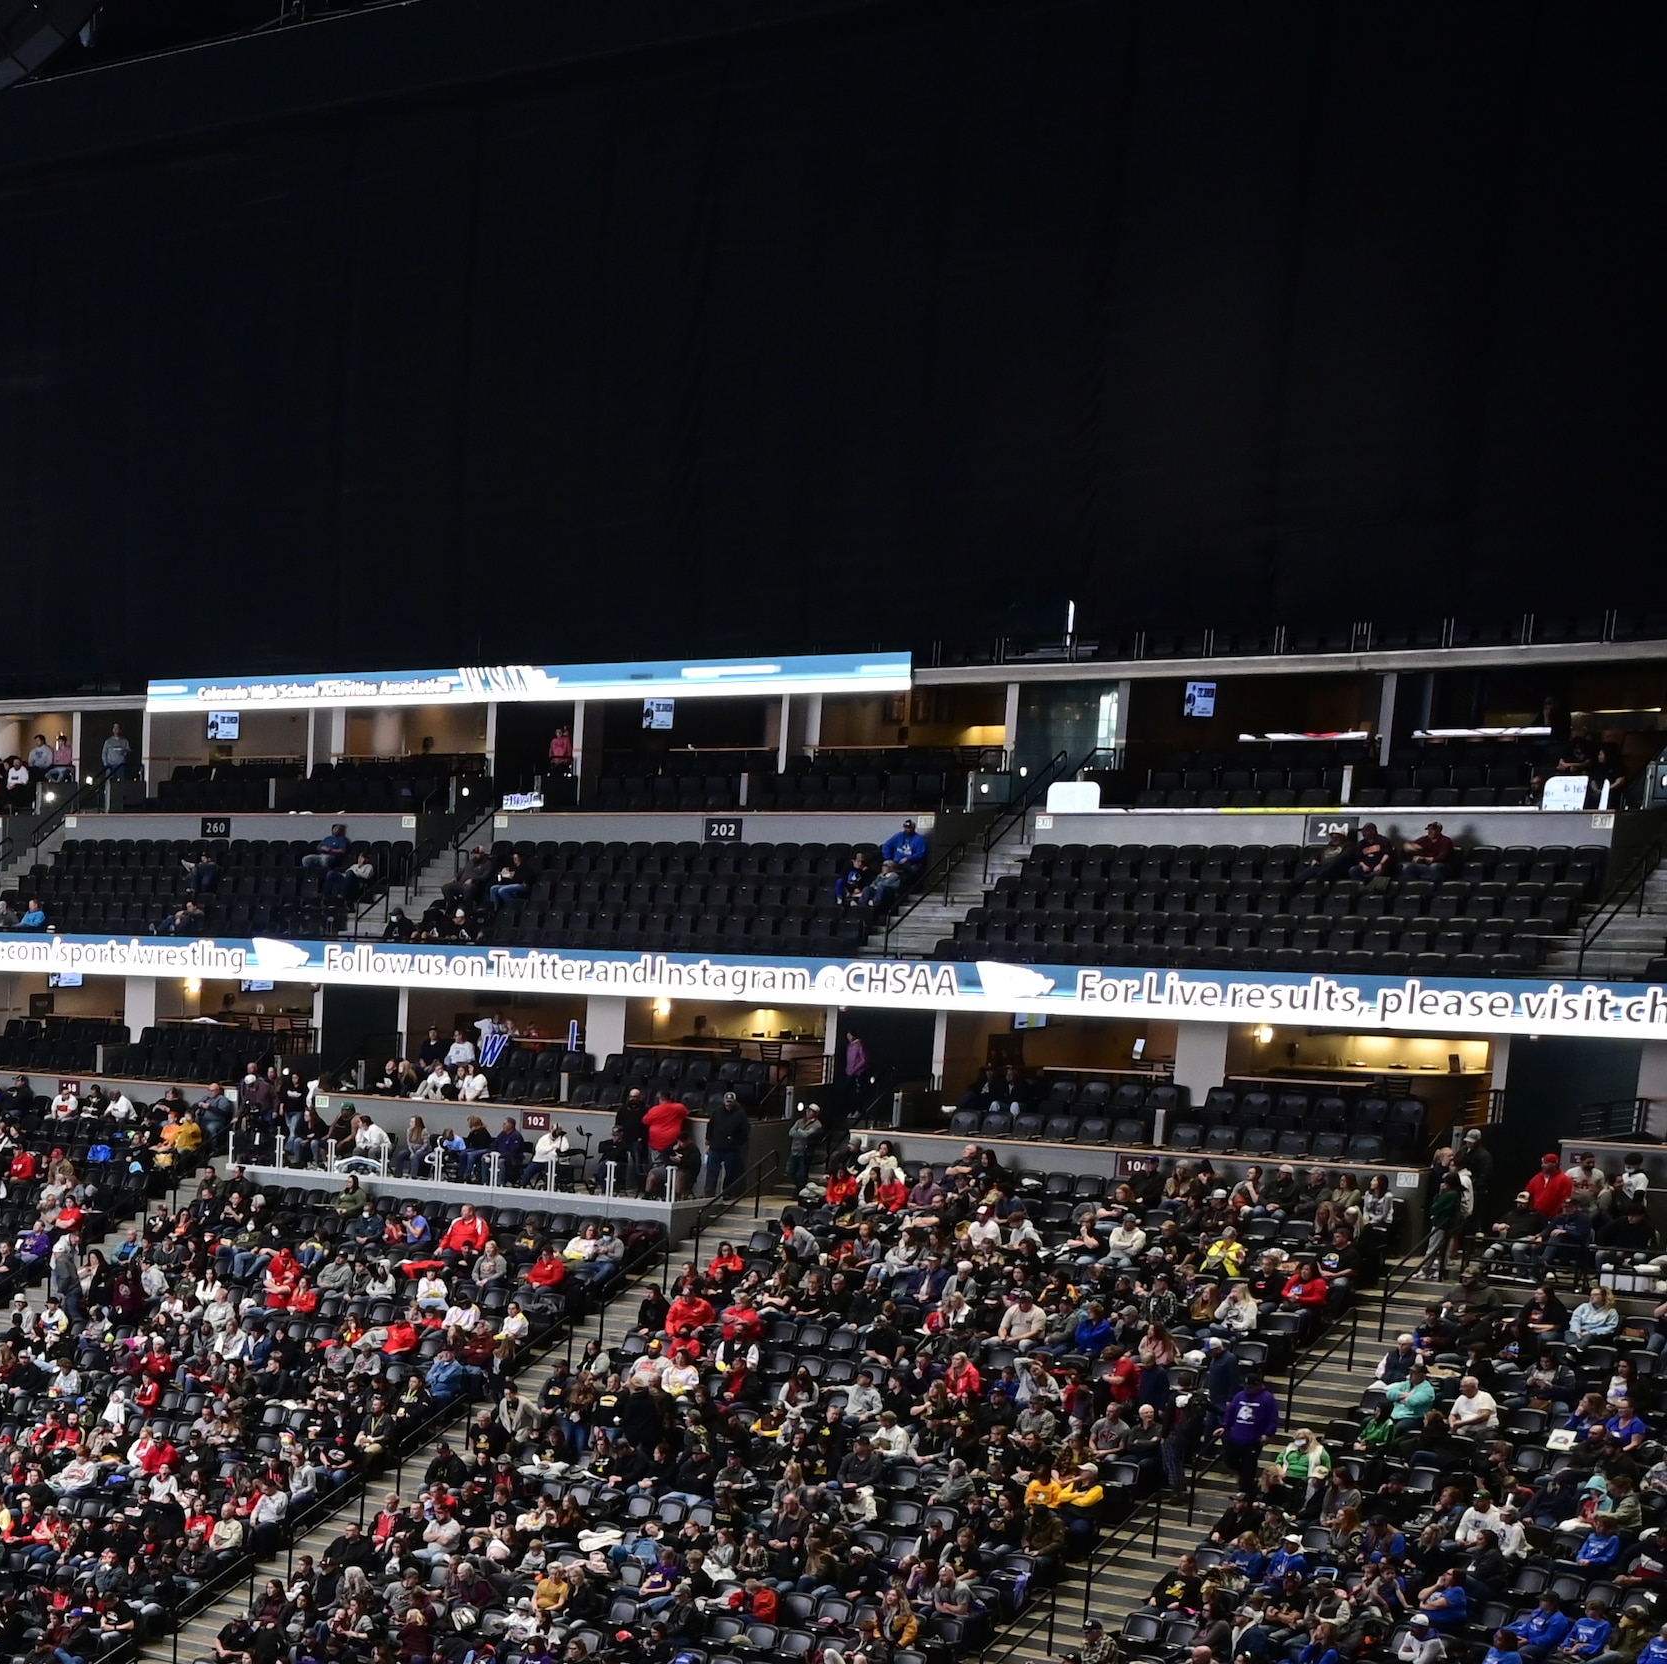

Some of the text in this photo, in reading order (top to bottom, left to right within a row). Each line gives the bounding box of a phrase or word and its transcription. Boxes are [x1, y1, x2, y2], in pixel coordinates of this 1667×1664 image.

[379, 678, 451, 697] Association
[205, 822, 226, 834] 260
[710, 824, 736, 837] 202
[327, 947, 411, 974] Follow
[416, 957, 446, 976] us
[453, 957, 484, 977] on
[491, 952, 588, 981] Twitter
[595, 955, 647, 983] and
[655, 958, 806, 996] Instagram
[1080, 973, 1135, 1002] For
[1146, 974, 1218, 1006] Live
[1230, 980, 1365, 1018] results,
[1381, 982, 1510, 1023] please
[1523, 987, 1609, 1023] visit
[527, 1096, 545, 1107] 102
